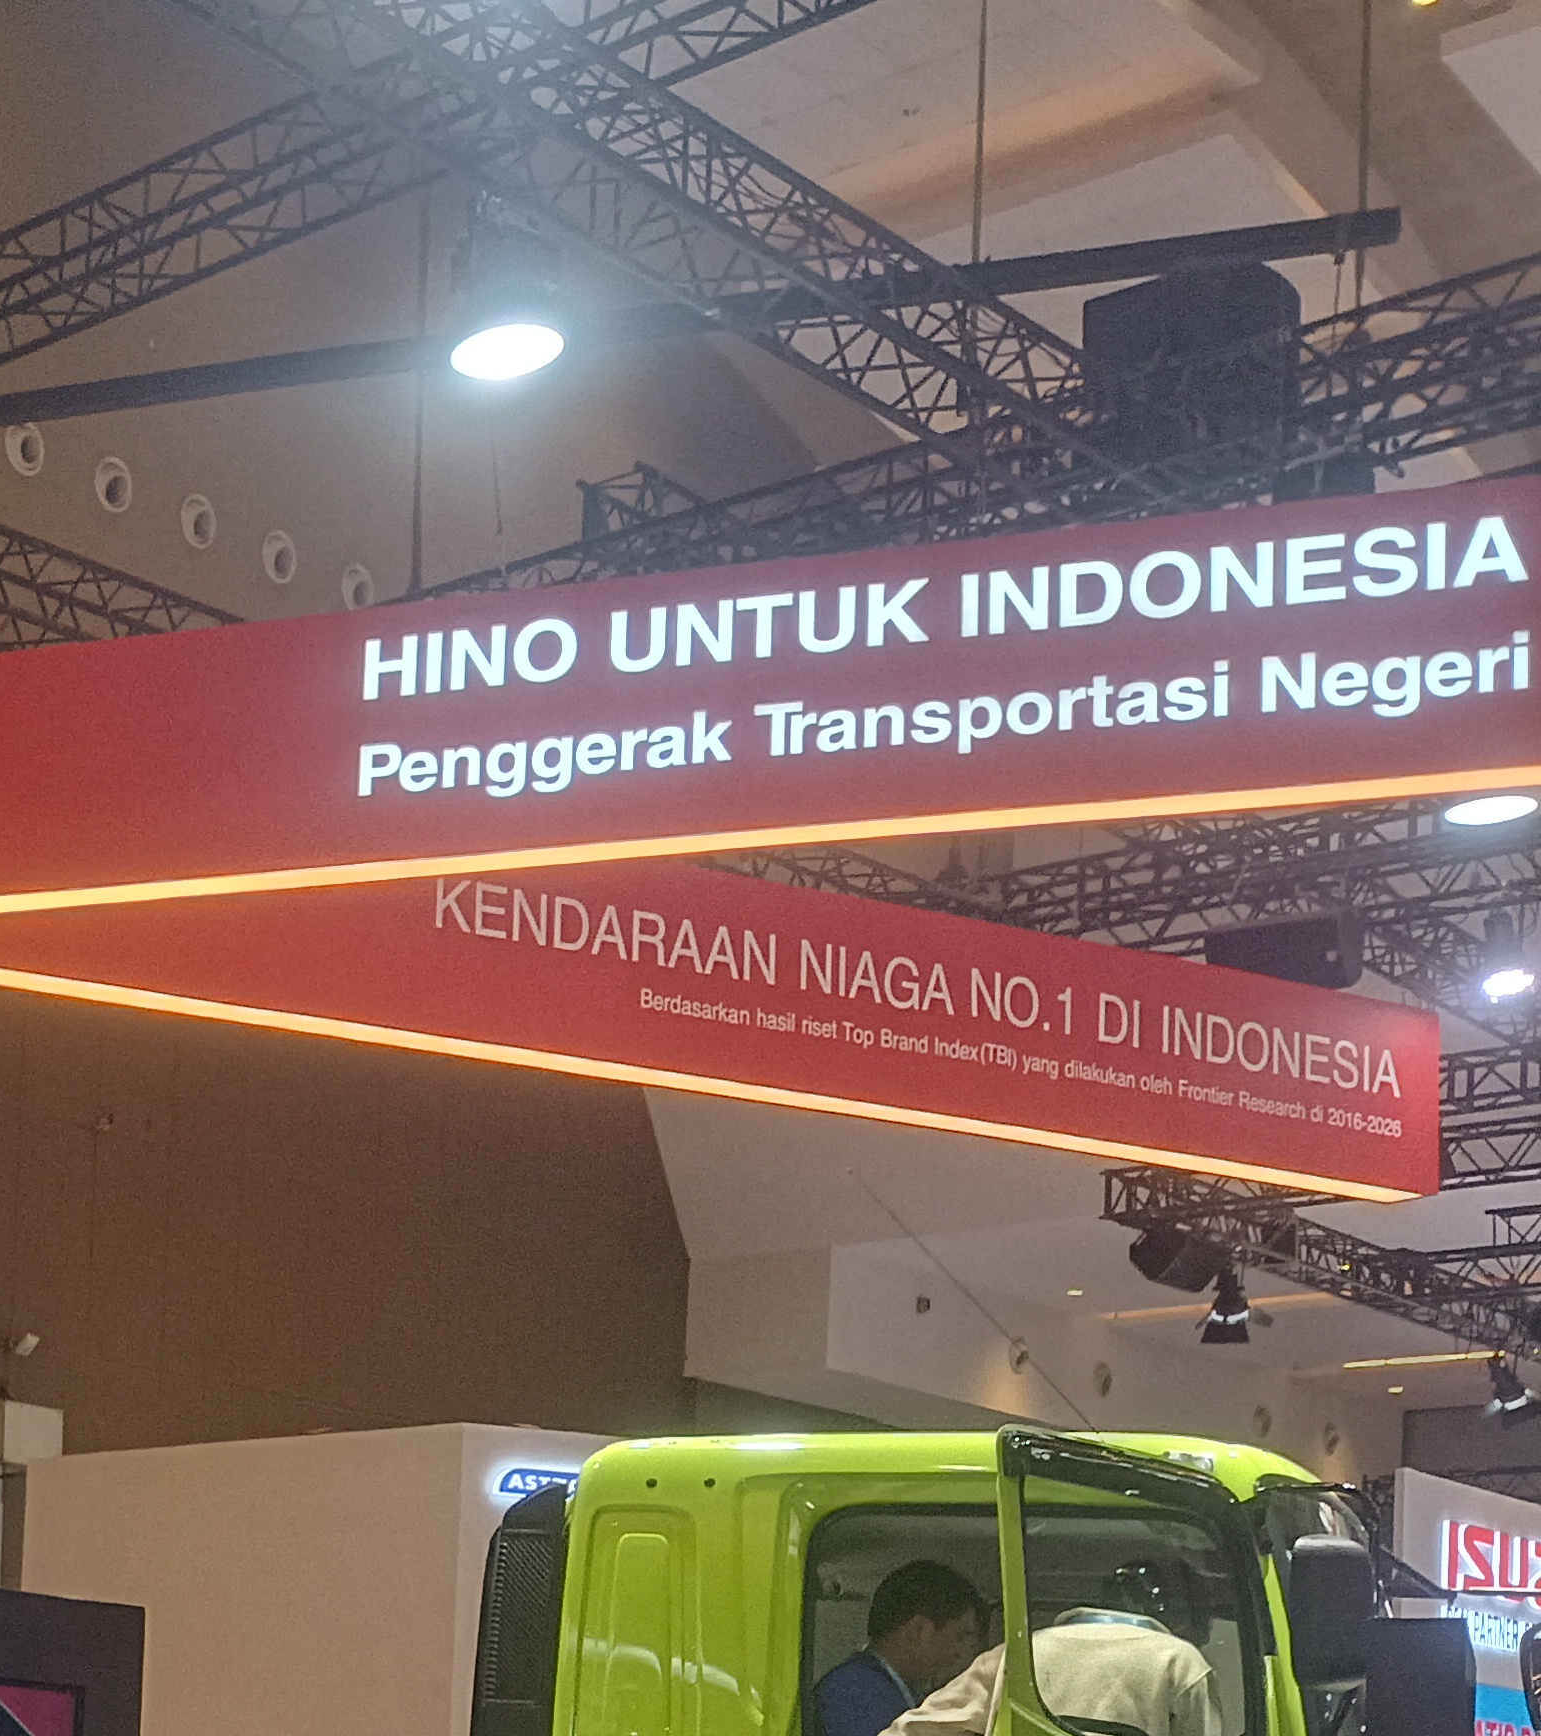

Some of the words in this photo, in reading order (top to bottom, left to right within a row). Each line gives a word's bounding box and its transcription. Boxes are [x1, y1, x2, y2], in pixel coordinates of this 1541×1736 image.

[361, 616, 577, 700] HINO
[610, 577, 931, 675] UNTUK
[960, 516, 1529, 637] INDONESIA
[355, 711, 735, 800] Penggerak
[755, 663, 1230, 760] Transportasi
[1260, 631, 1531, 720] Negeri
[434, 878, 776, 985] KENDARAAN
[799, 938, 955, 1017] NIAGA
[971, 967, 1075, 1036] NO.1
[1098, 989, 1140, 1051] DI
[1162, 1003, 1401, 1099] INDONESIA
[640, 987, 751, 1027] Berdasarkan
[756, 1006, 796, 1034] hasil
[801, 1016, 838, 1040] riset
[842, 1021, 875, 1049] Top
[880, 1028, 929, 1055] Brand
[1022, 1053, 1059, 1080] yang
[1065, 1062, 1136, 1090] dilakukan
[1140, 1072, 1173, 1096] oleh
[1178, 1078, 1235, 1107] Frontier
[1239, 1091, 1306, 1122] Research
[1310, 1103, 1324, 1122] di
[1441, 1519, 1541, 1606] ISU
